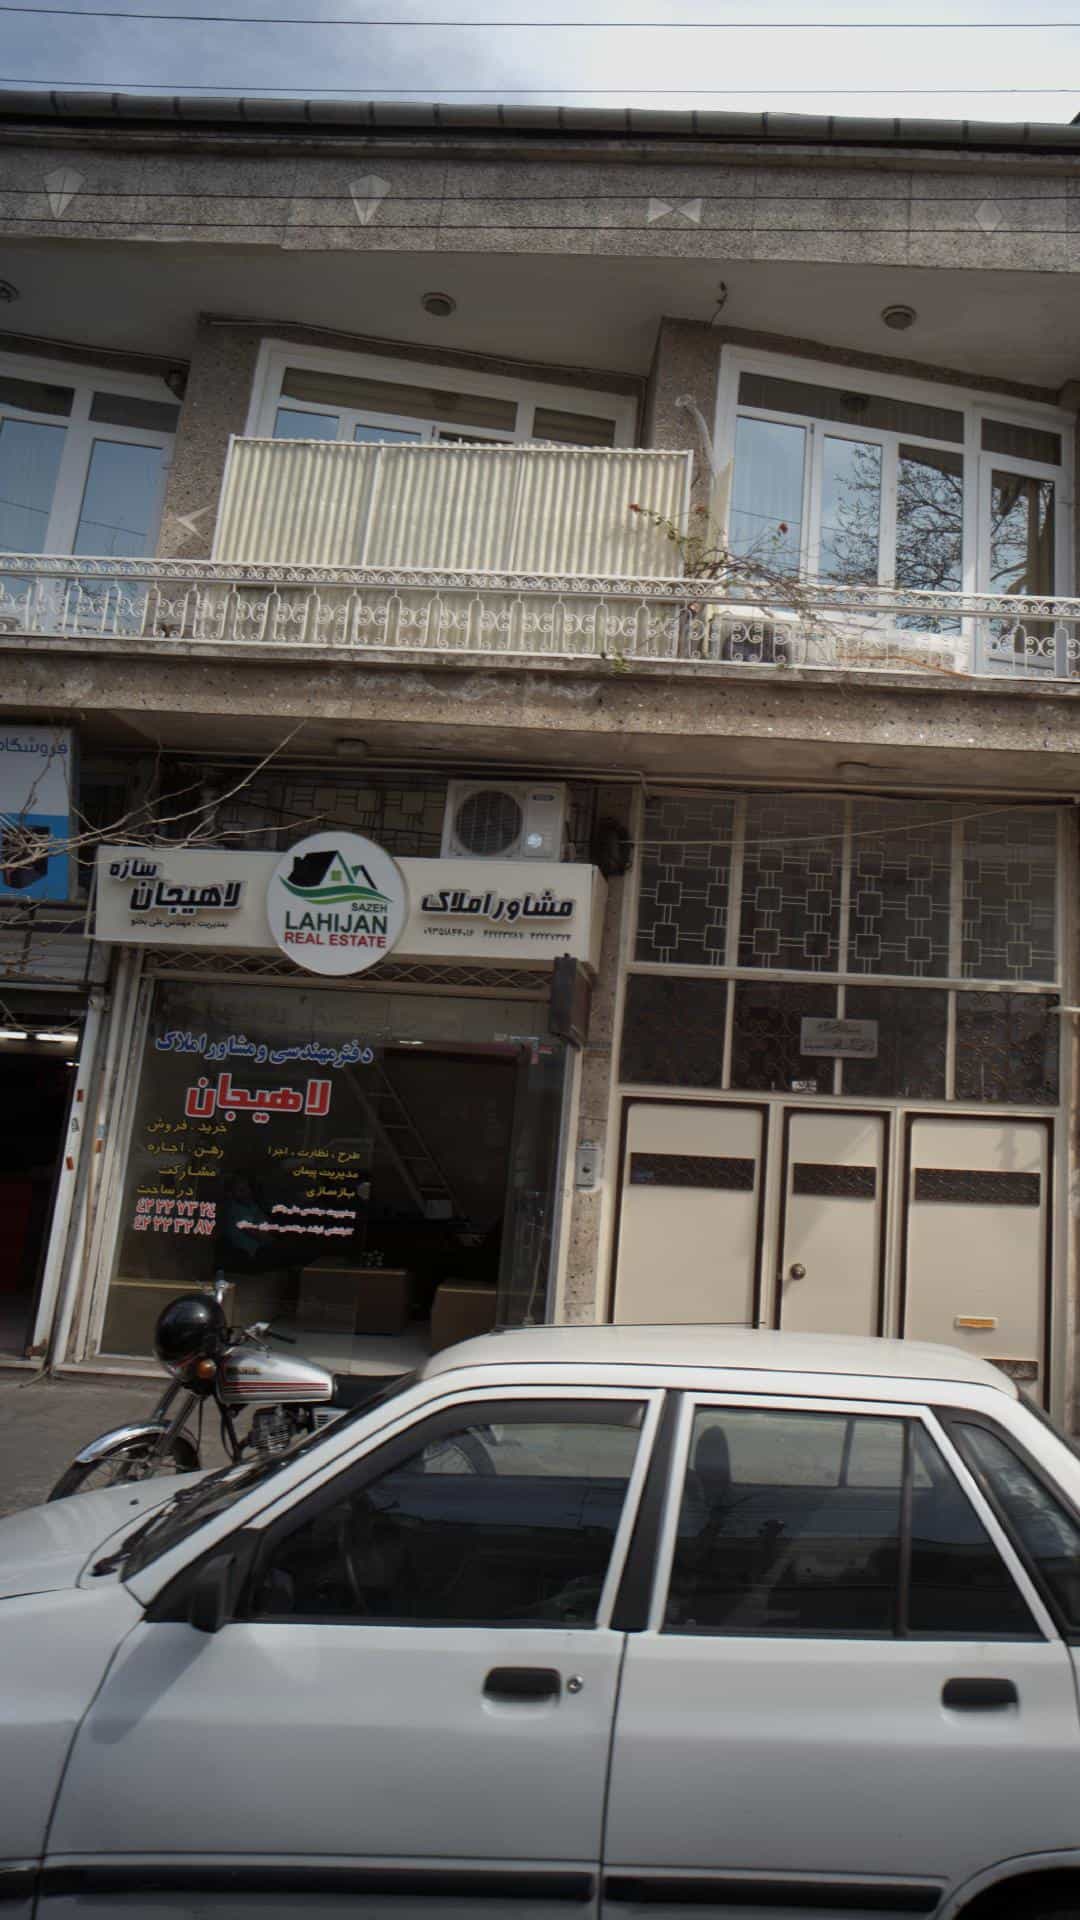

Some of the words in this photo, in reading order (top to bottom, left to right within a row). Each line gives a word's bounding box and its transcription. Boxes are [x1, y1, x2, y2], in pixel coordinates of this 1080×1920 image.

[109, 859, 158, 879] سازه
[129, 881, 241, 915] لاهیجان
[351, 902, 388, 913] SAZEH
[421, 891, 492, 914] املاک
[491, 890, 574, 921] مشاور
[285, 911, 388, 934] LAHIJAN
[284, 932, 324, 945] REAL
[329, 934, 387, 949] ESTATE
[155, 1031, 207, 1053] املاک
[203, 1034, 256, 1060] مشاور
[254, 1044, 268, 1063] و
[269, 1042, 337, 1064] مهندسی
[332, 1040, 374, 1068] دفتر
[185, 1072, 332, 1123] لاهیجان
[147, 1117, 188, 1133] فروش
[198, 1120, 228, 1134] خرید
[146, 1142, 184, 1154] اجاره
[194, 1144, 224, 1159] رهن
[158, 1164, 216, 1180] مشارکت
